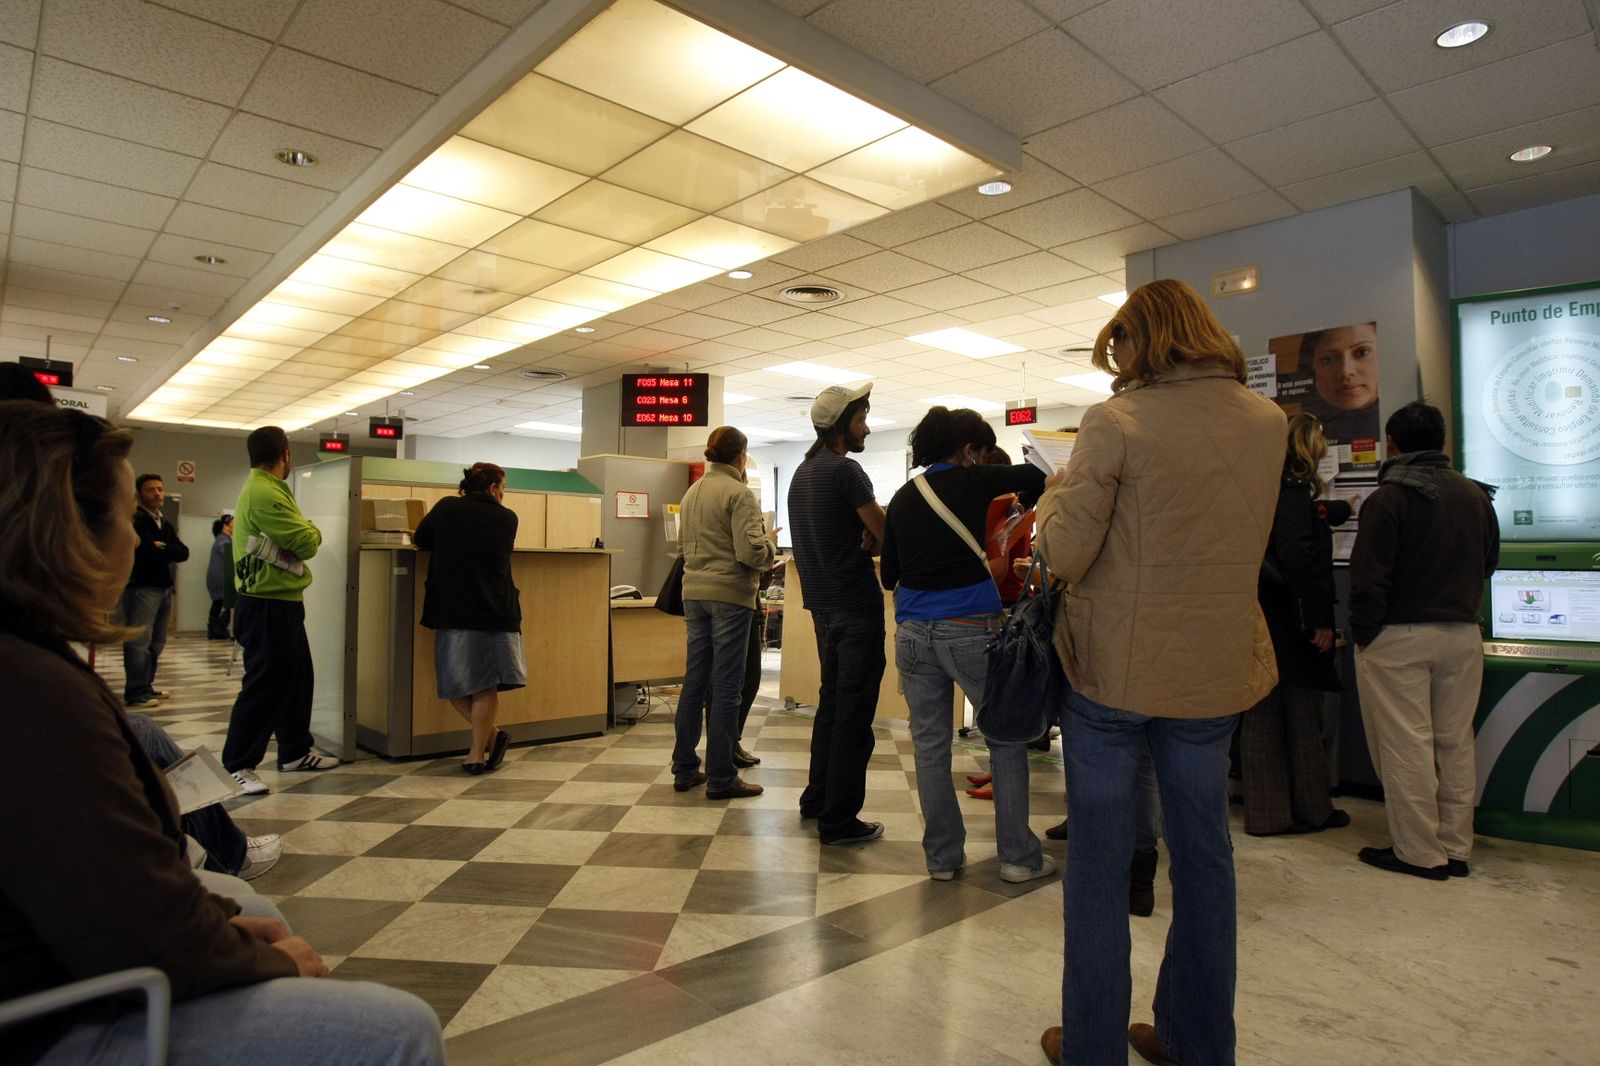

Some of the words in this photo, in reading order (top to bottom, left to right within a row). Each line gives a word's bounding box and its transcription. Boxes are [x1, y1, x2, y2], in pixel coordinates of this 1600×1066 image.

[1490, 308, 1537, 325] Punto
[1543, 304, 1563, 319] de
[1536, 367, 1575, 382] Imprimir
[659, 378, 679, 387] Mesa
[683, 378, 693, 387] 11
[636, 395, 656, 404] C023
[659, 395, 679, 404] Mesa
[681, 395, 688, 404] 6
[636, 413, 656, 422] E062
[659, 413, 679, 422] Mesa
[682, 413, 693, 422] 10
[1010, 409, 1032, 423] E062
